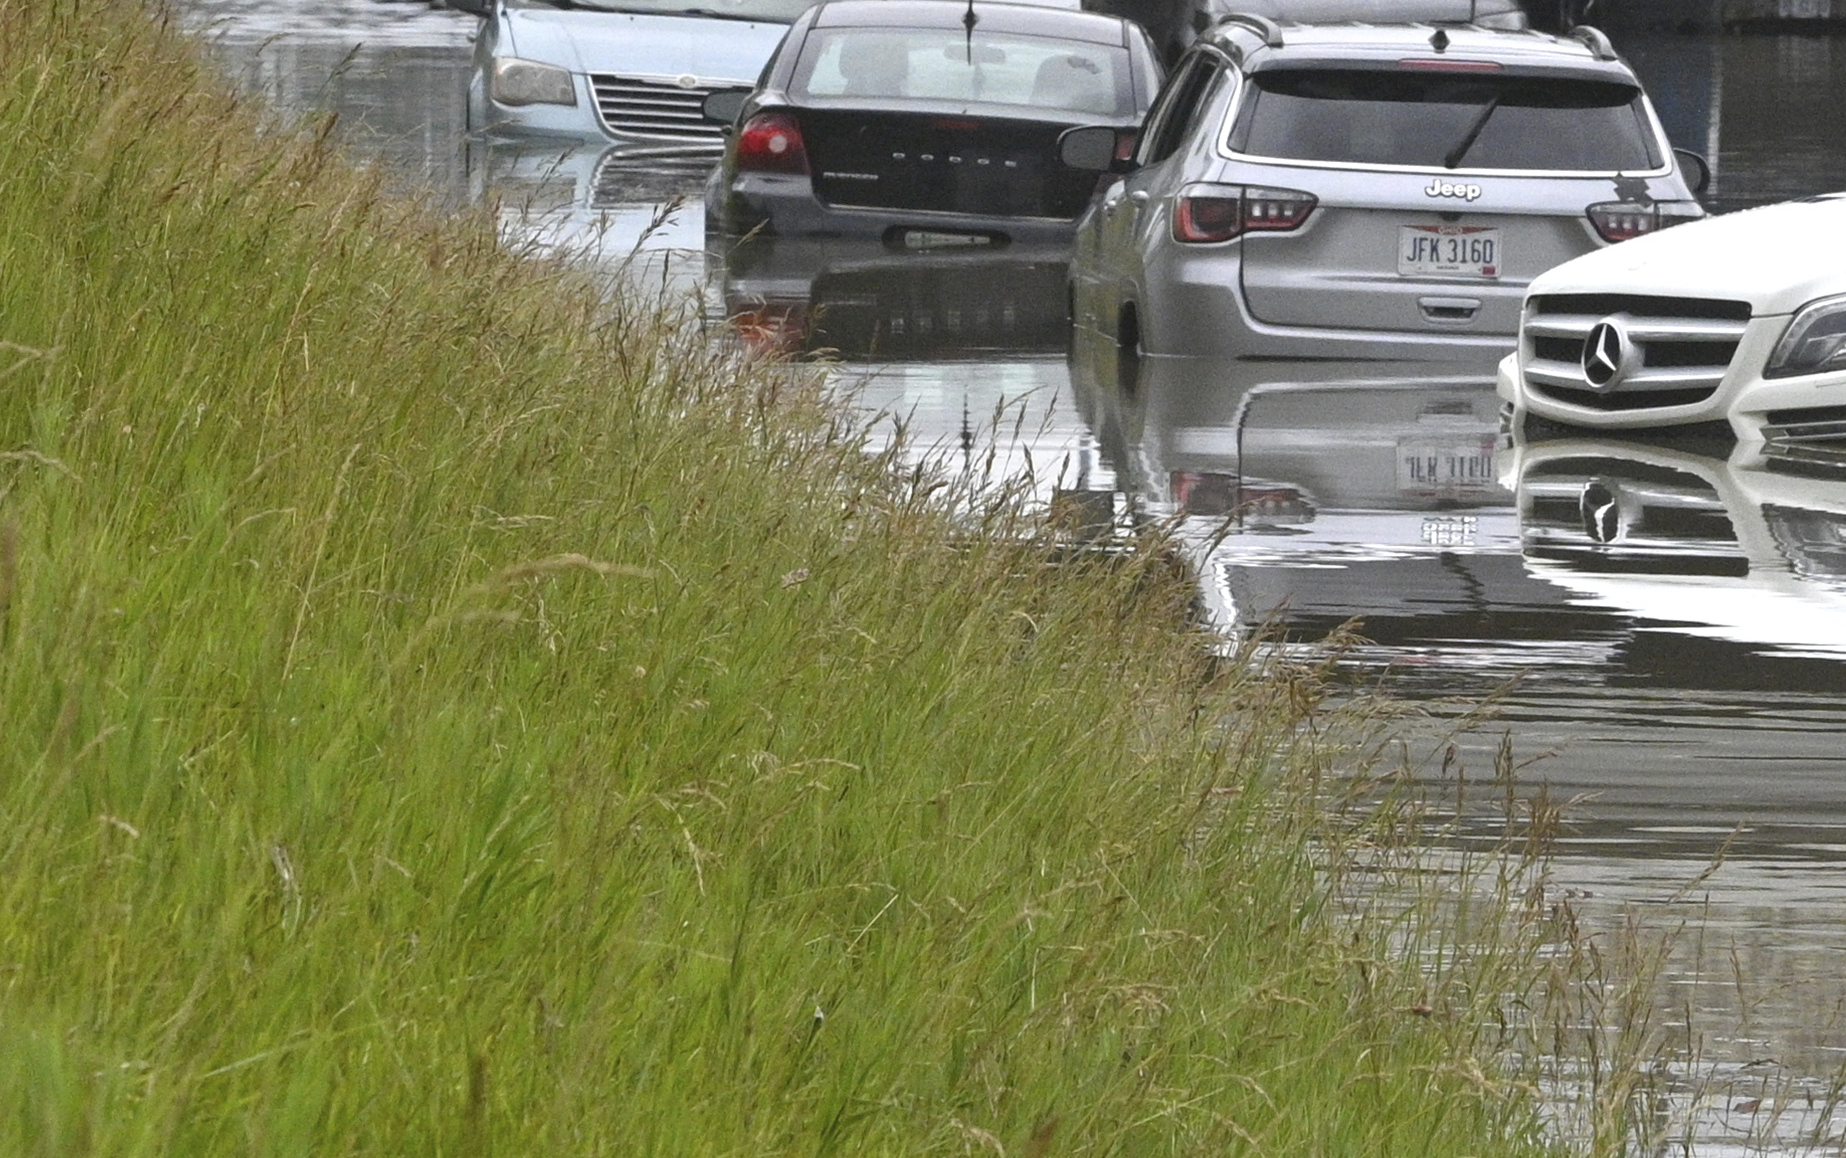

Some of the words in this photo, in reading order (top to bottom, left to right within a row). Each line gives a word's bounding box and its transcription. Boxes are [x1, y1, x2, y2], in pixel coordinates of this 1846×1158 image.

[893, 152, 1017, 167] DODGE
[1425, 179, 1481, 202] Jeep
[1406, 236, 1441, 263] JFK
[1447, 238, 1494, 264] 3160
